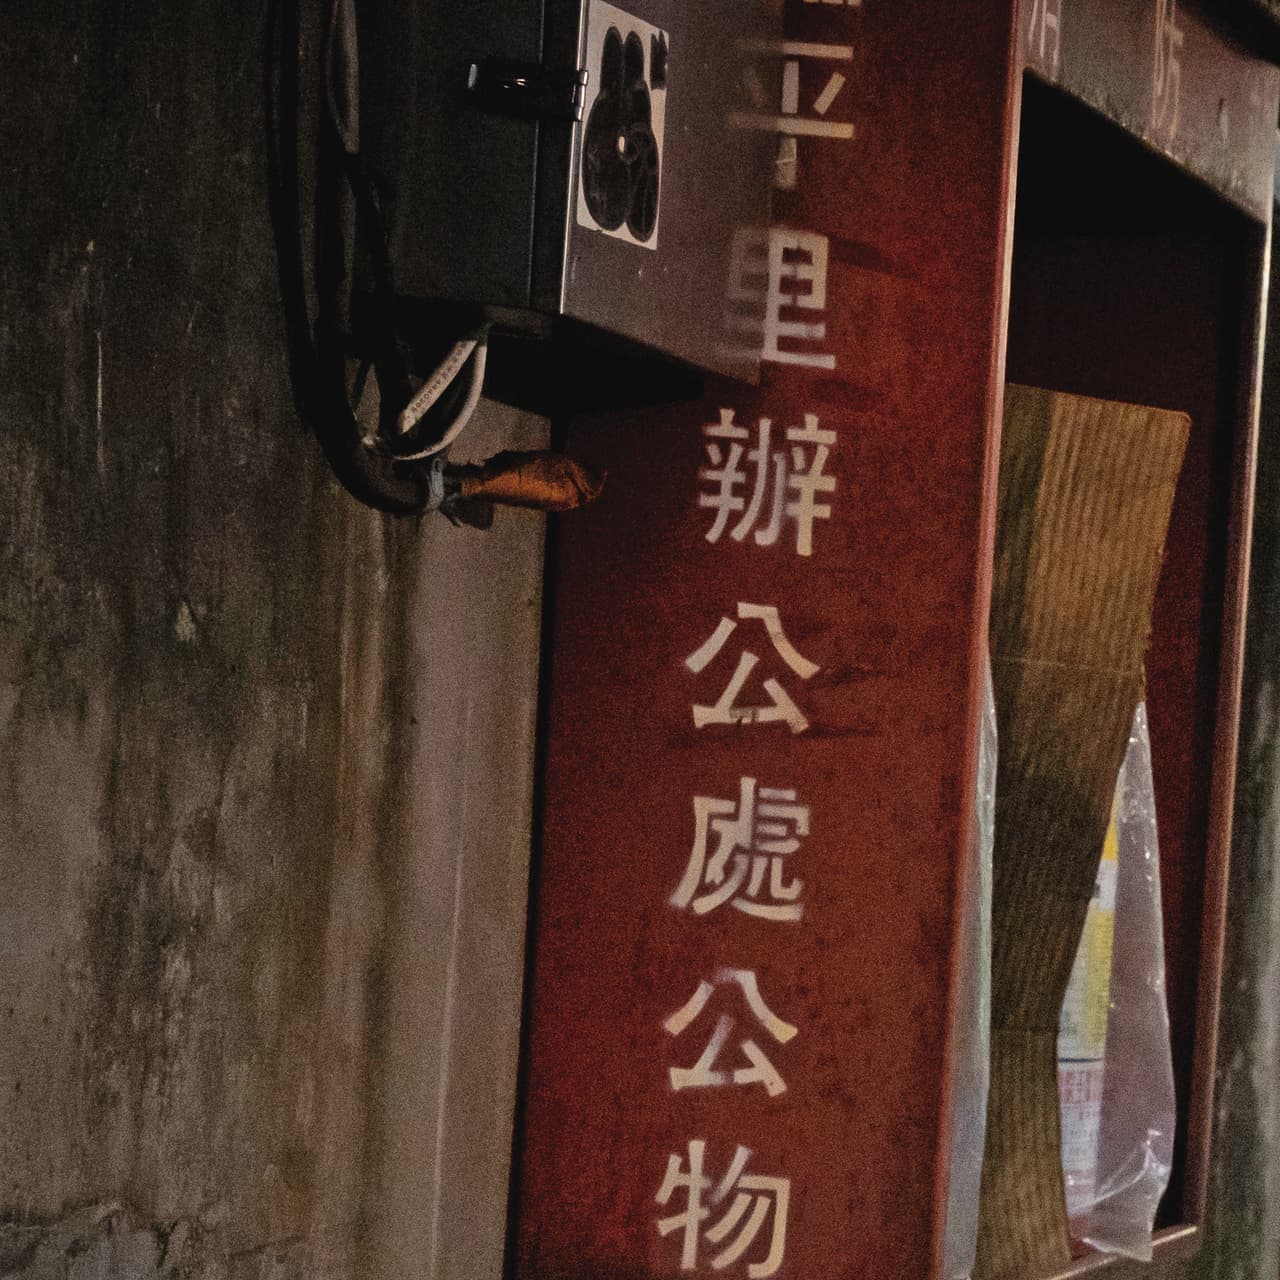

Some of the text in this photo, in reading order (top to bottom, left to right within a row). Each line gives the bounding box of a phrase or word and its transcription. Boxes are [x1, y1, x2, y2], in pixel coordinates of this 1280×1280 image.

[655, 0, 861, 1279] 平里辦公處公物
